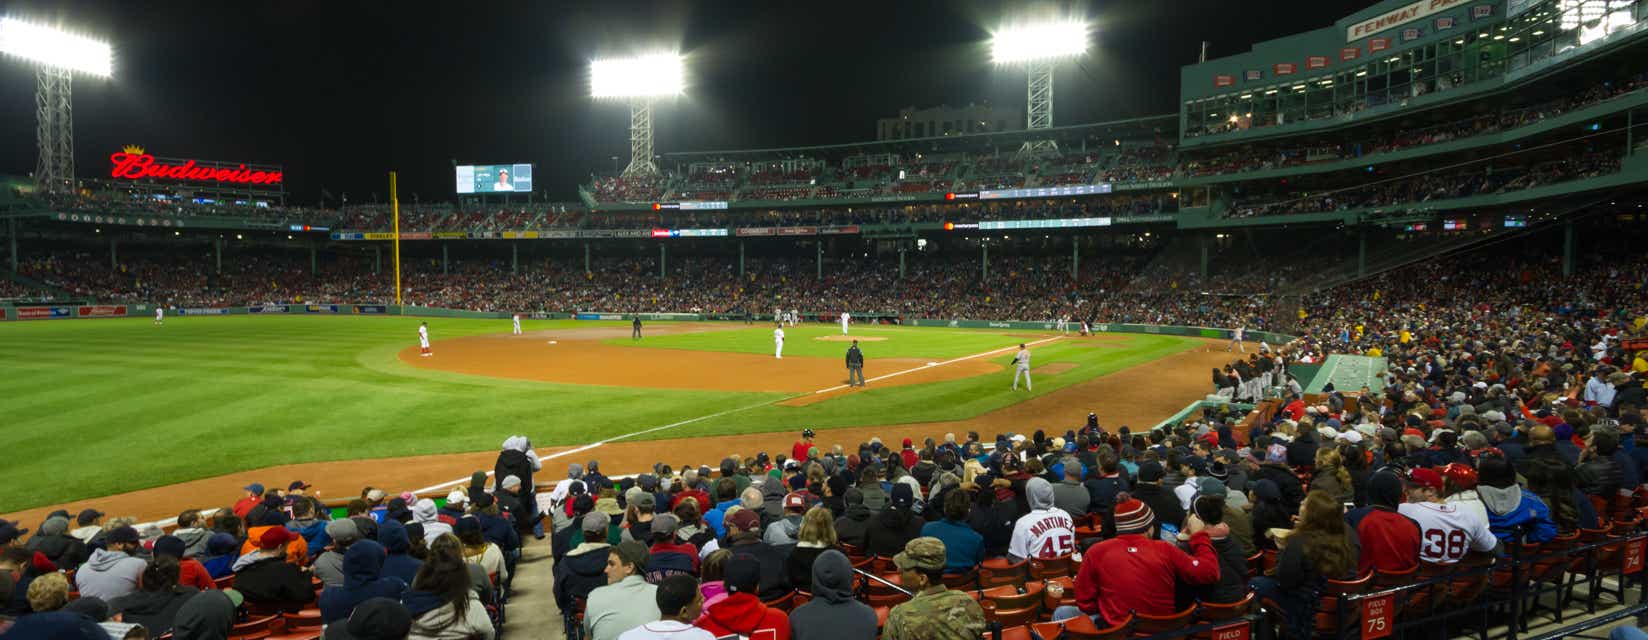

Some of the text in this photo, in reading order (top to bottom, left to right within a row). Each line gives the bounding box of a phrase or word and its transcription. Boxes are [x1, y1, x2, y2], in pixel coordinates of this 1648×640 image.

[1354, 6, 1419, 36] FENWAY
[110, 152, 283, 185] Budweiser
[1424, 528, 1466, 559] 38
[1368, 617, 1385, 633] 75
